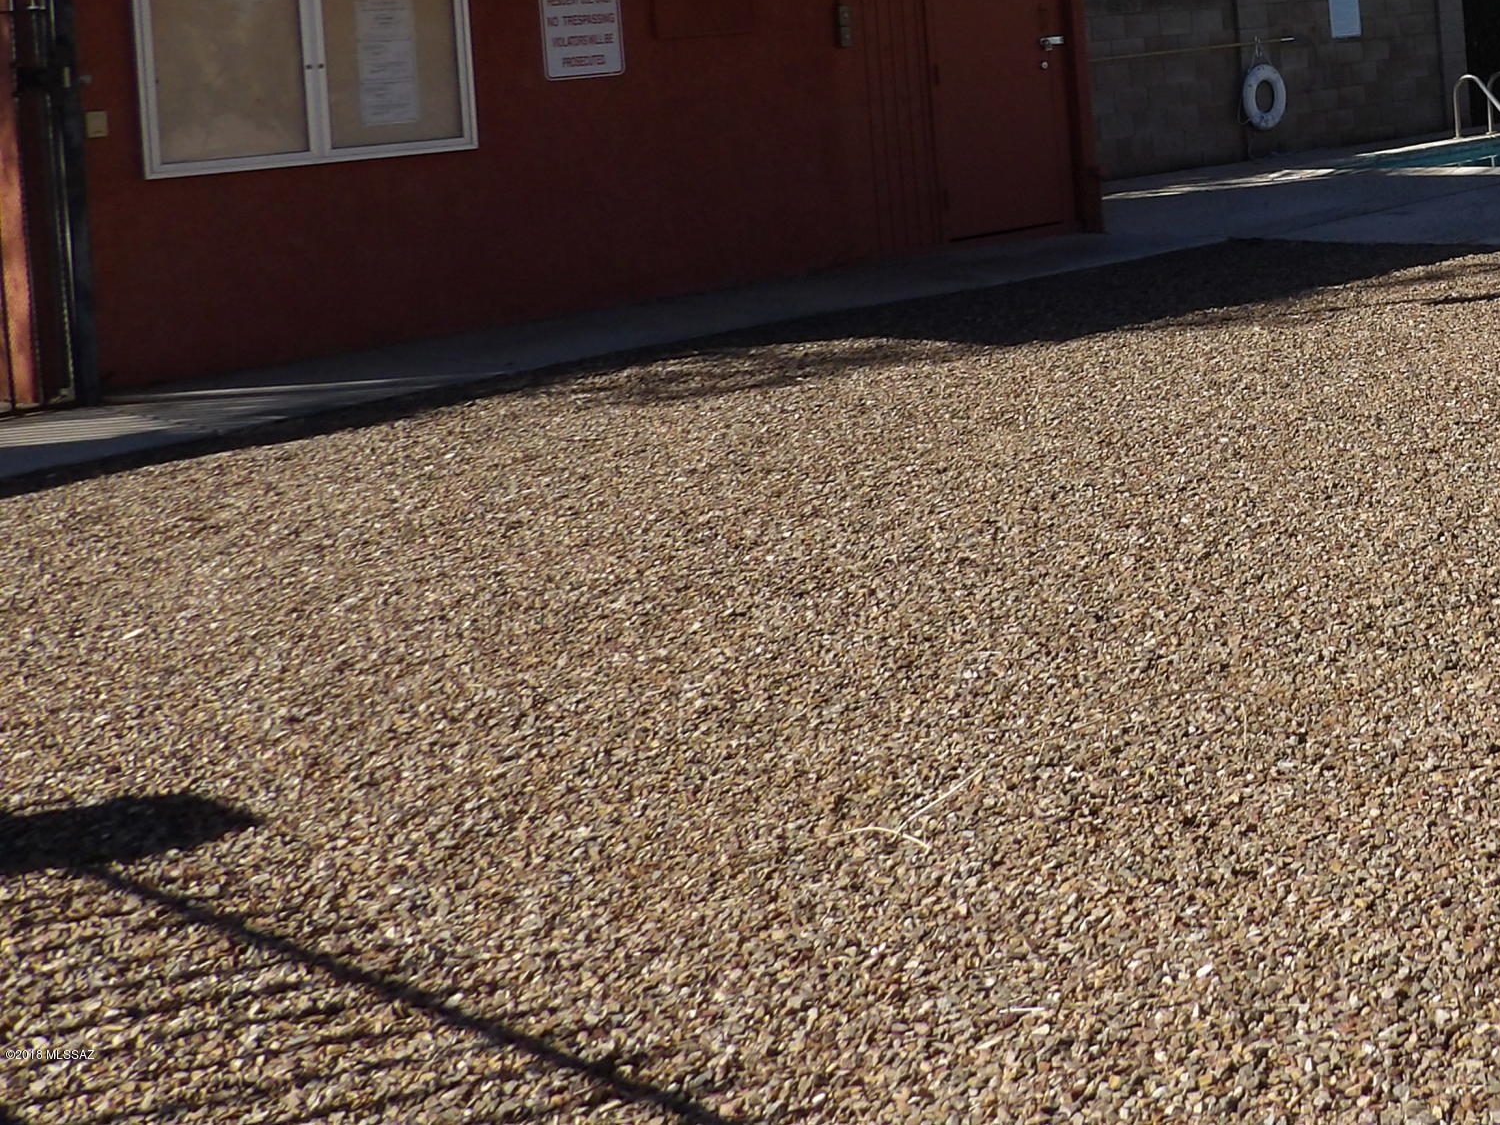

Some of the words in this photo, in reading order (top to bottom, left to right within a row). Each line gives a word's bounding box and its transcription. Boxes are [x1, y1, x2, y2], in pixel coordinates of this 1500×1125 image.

[547, 16, 559, 27] NO
[562, 13, 615, 26] TRESPASSING
[604, 33, 614, 44] BE
